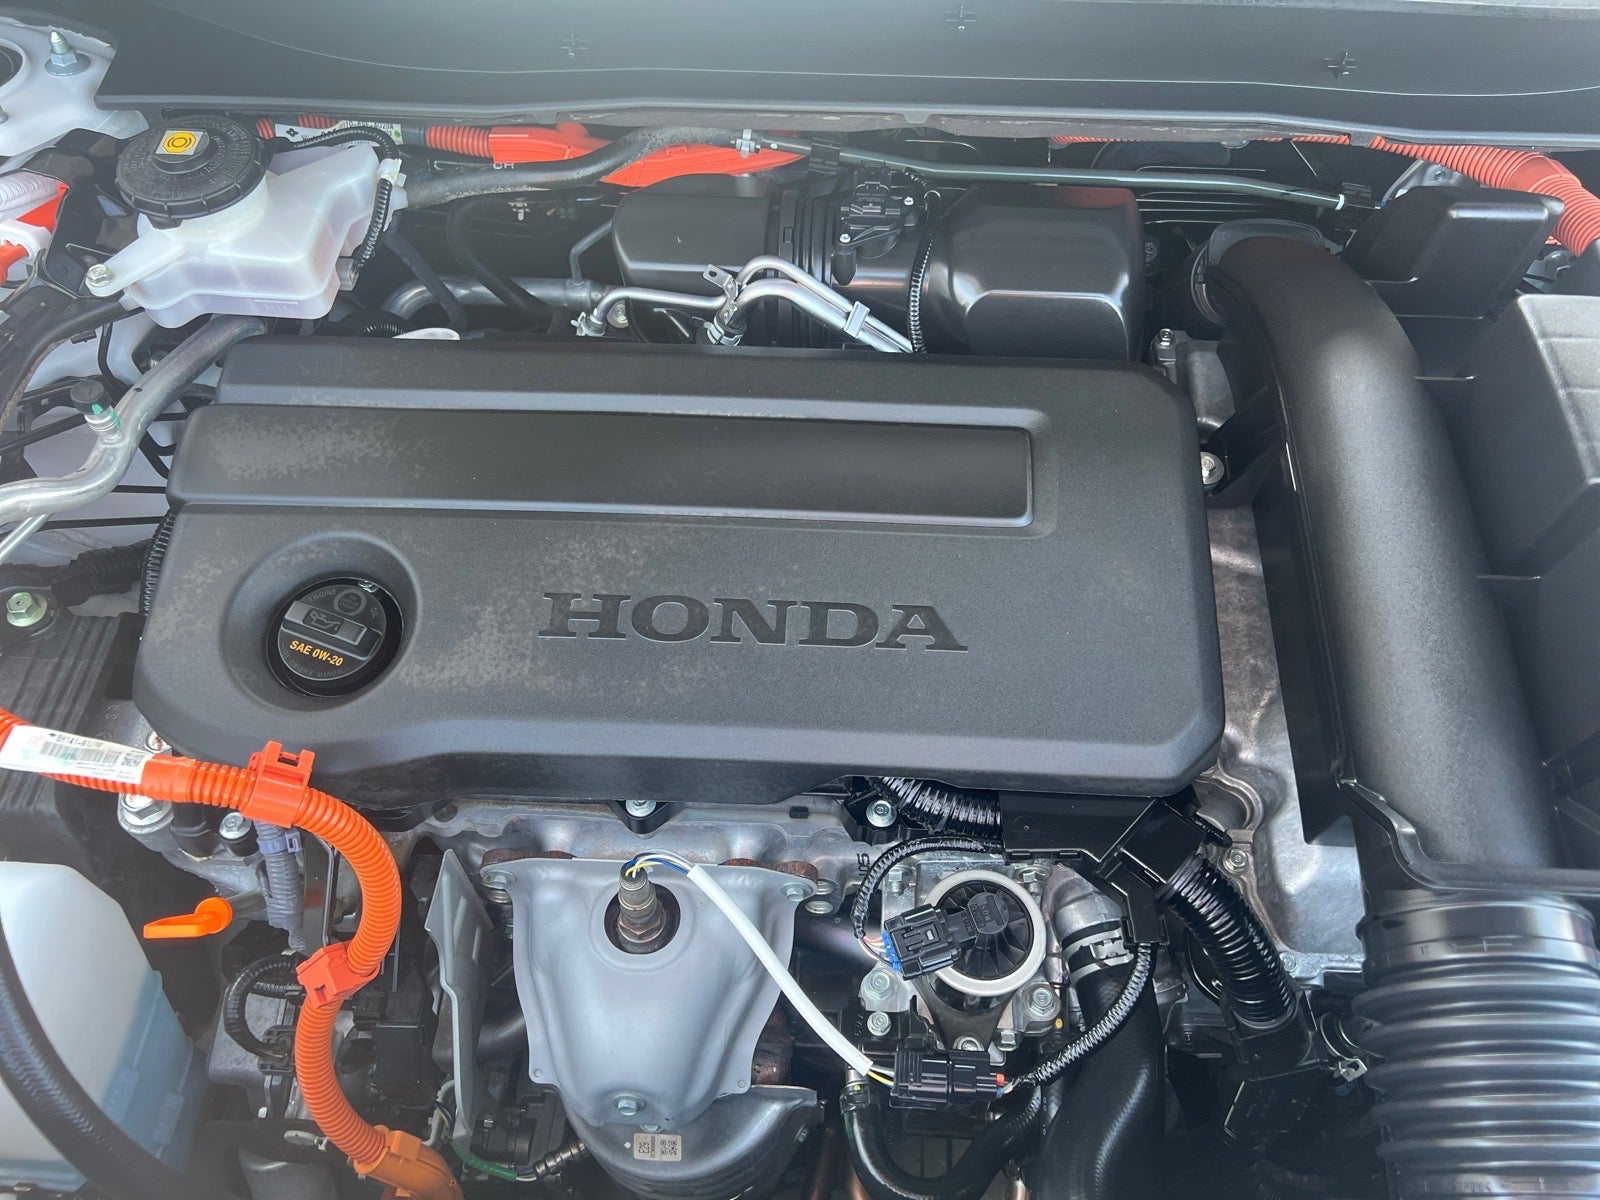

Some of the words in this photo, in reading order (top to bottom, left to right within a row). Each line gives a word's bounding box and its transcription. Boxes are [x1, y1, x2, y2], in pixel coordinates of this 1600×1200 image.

[537, 592, 969, 653] HONDA
[290, 640, 312, 655] SAE
[312, 648, 344, 667] 0W-20
[638, 1141, 649, 1154] E29
